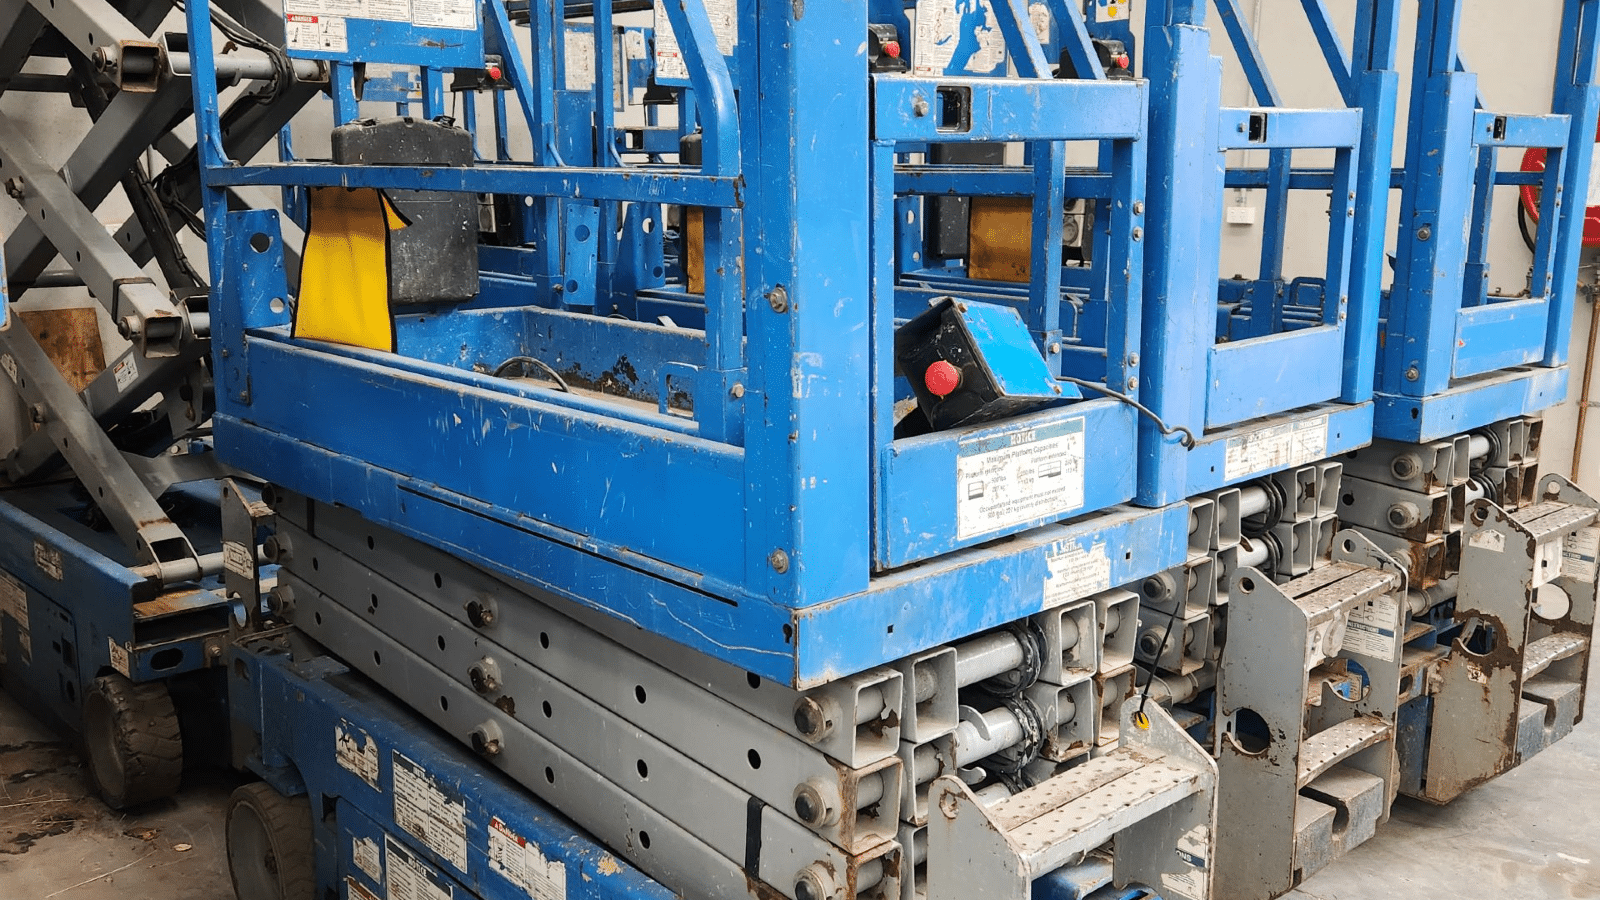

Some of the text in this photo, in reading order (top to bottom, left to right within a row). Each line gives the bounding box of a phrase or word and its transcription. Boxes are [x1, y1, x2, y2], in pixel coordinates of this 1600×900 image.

[986, 442, 1058, 463] Maximum Platform Capacities
[965, 470, 983, 478] Platform
